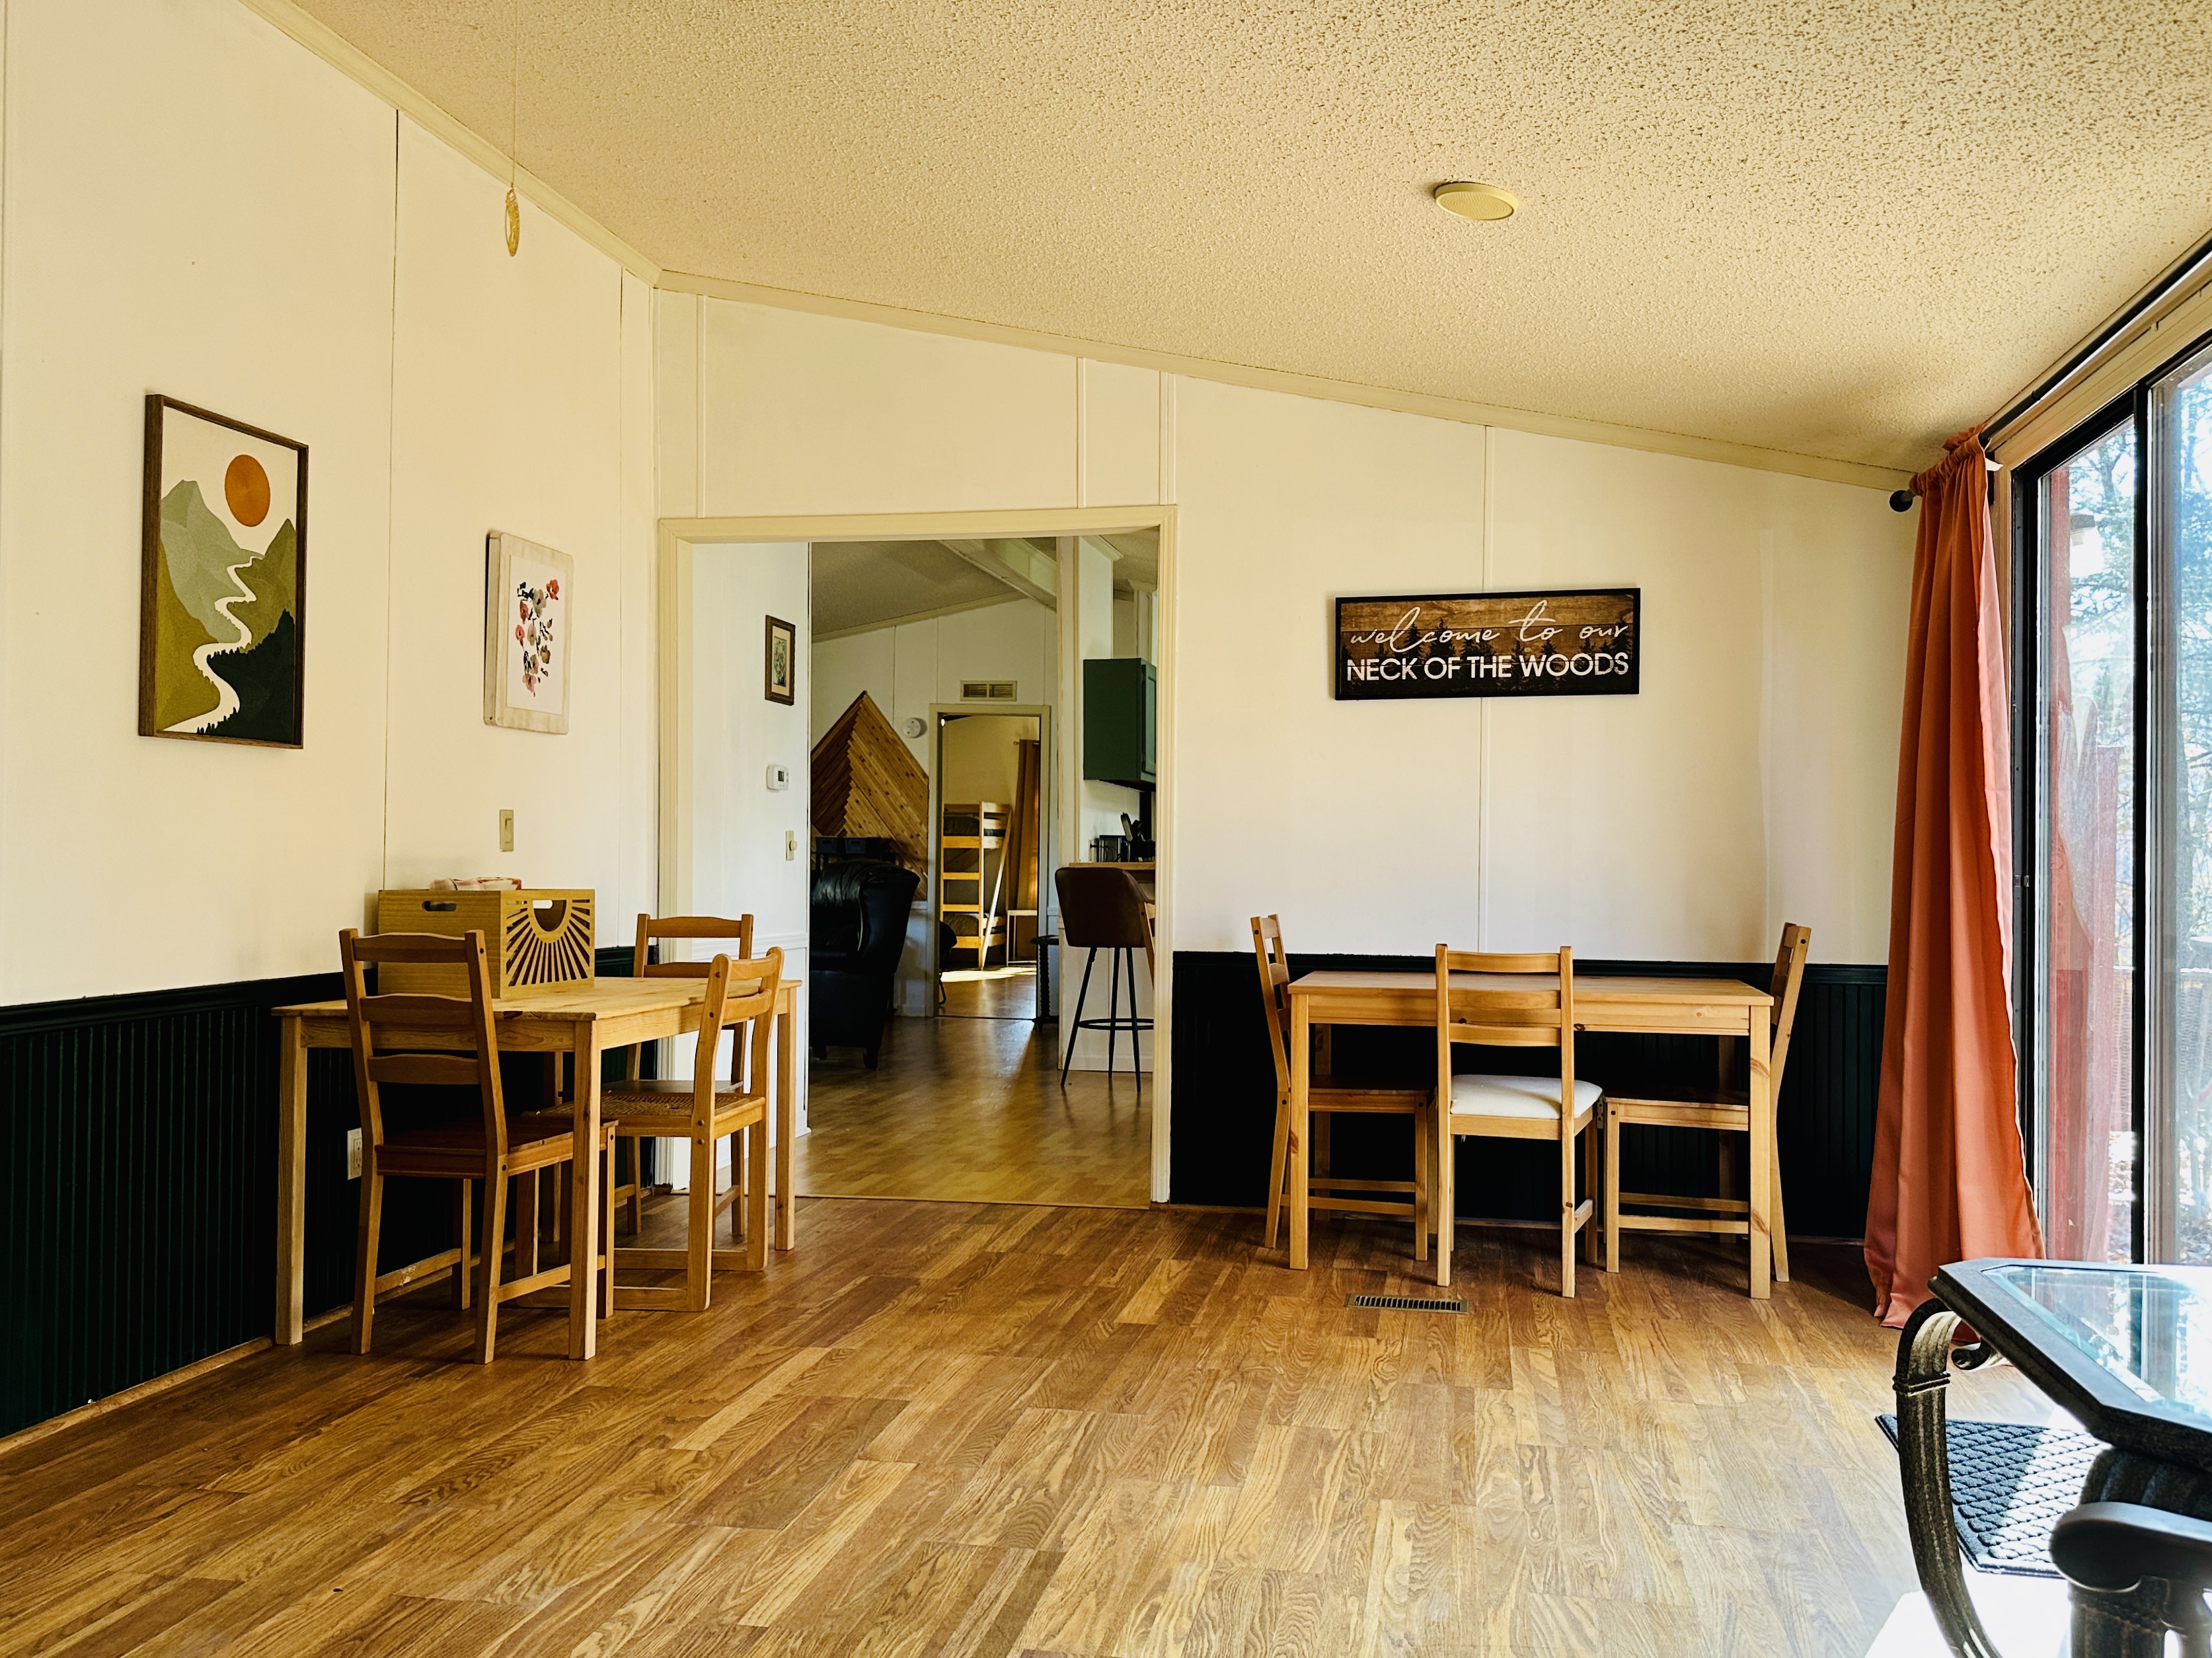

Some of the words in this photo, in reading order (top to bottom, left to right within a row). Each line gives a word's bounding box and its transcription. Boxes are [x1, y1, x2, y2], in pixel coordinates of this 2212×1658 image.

[1351, 607, 1500, 653] welcome
[1508, 600, 1563, 642] to
[1579, 624, 1629, 639] our
[1347, 658, 1418, 681] NECK
[1424, 656, 1461, 679] OF
[1467, 655, 1511, 678] THE
[1519, 652, 1628, 677] WOODS
